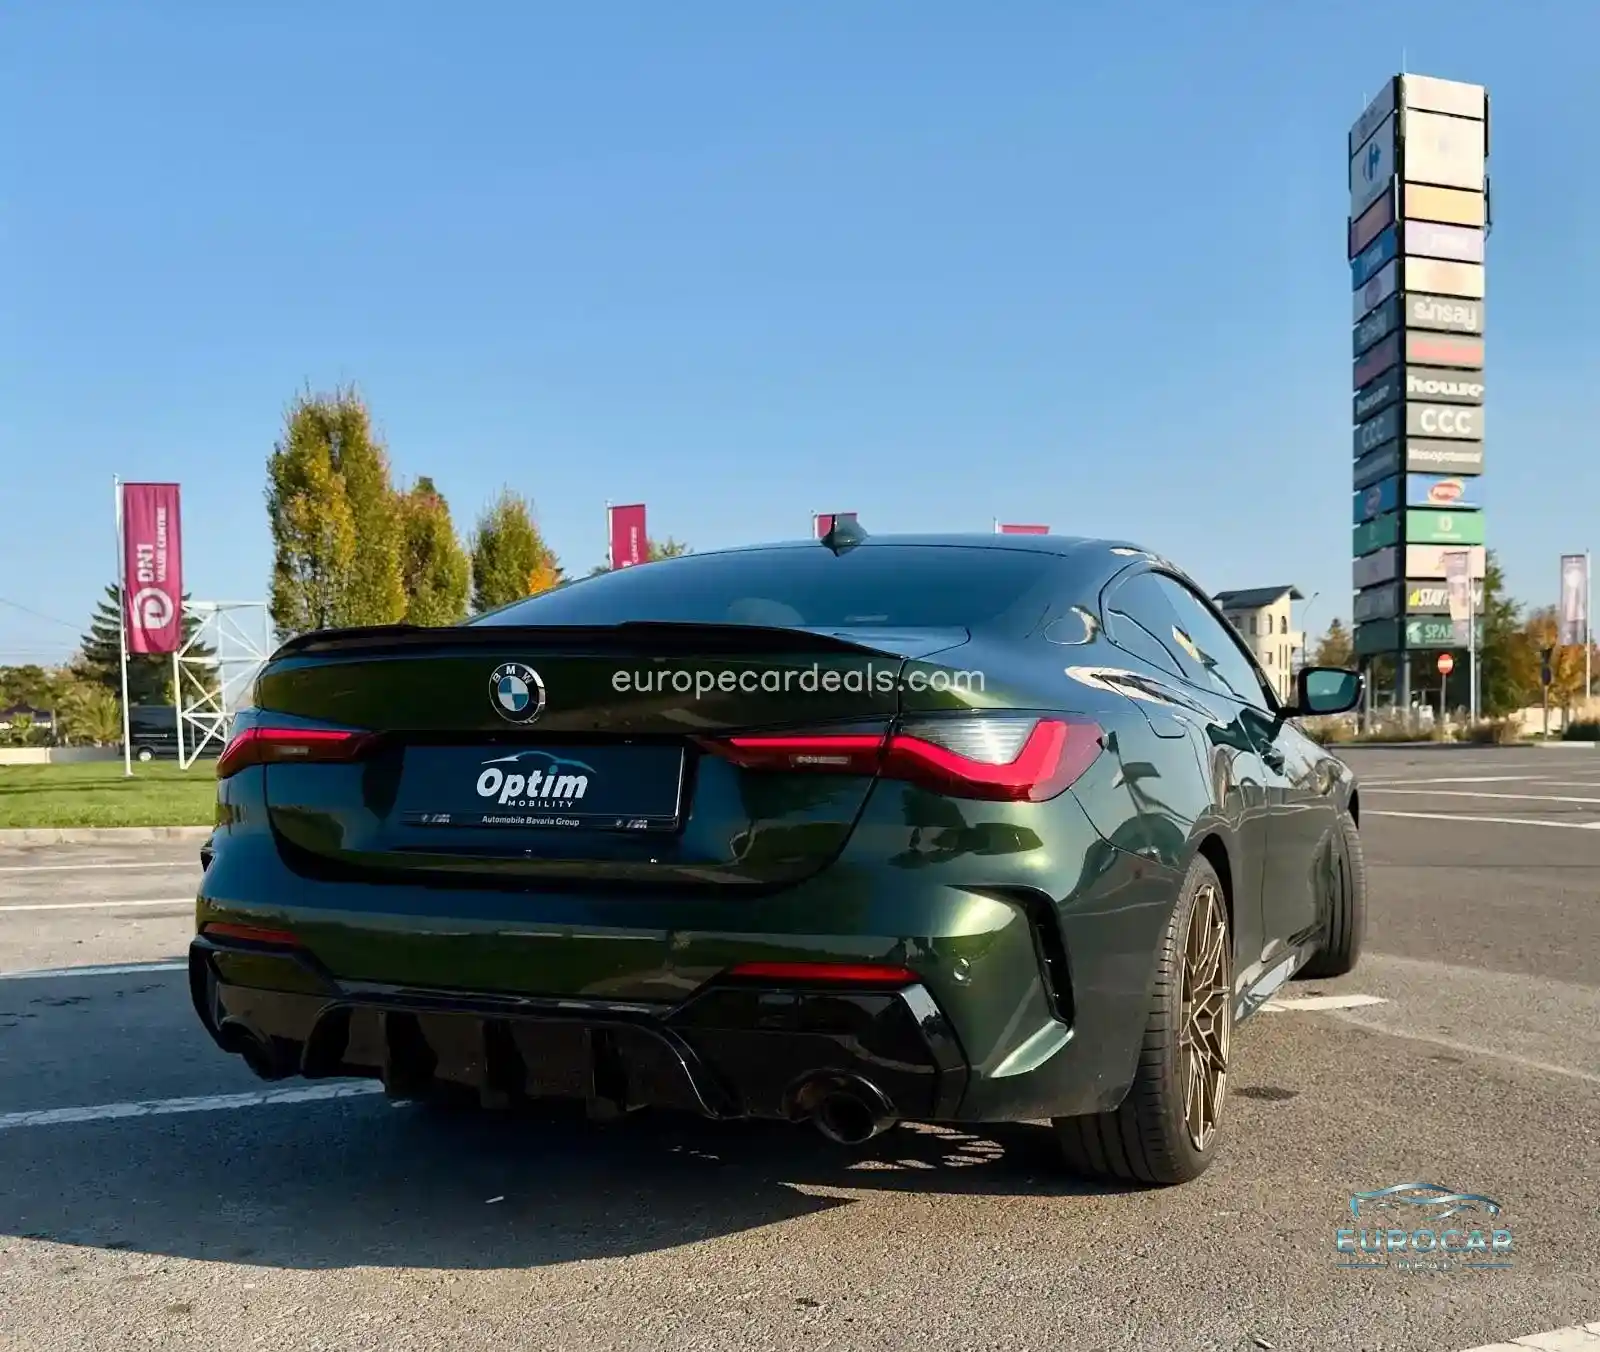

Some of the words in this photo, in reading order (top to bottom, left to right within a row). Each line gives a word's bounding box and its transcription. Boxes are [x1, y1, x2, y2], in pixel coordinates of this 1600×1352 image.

[1420, 408, 1472, 434] CCC
[492, 665, 533, 684] BMW
[476, 767, 588, 805] Optim
[507, 800, 573, 808] MOBILITY
[482, 815, 525, 825] Automobile
[526, 816, 555, 826] Bavaria
[555, 817, 580, 828] Group
